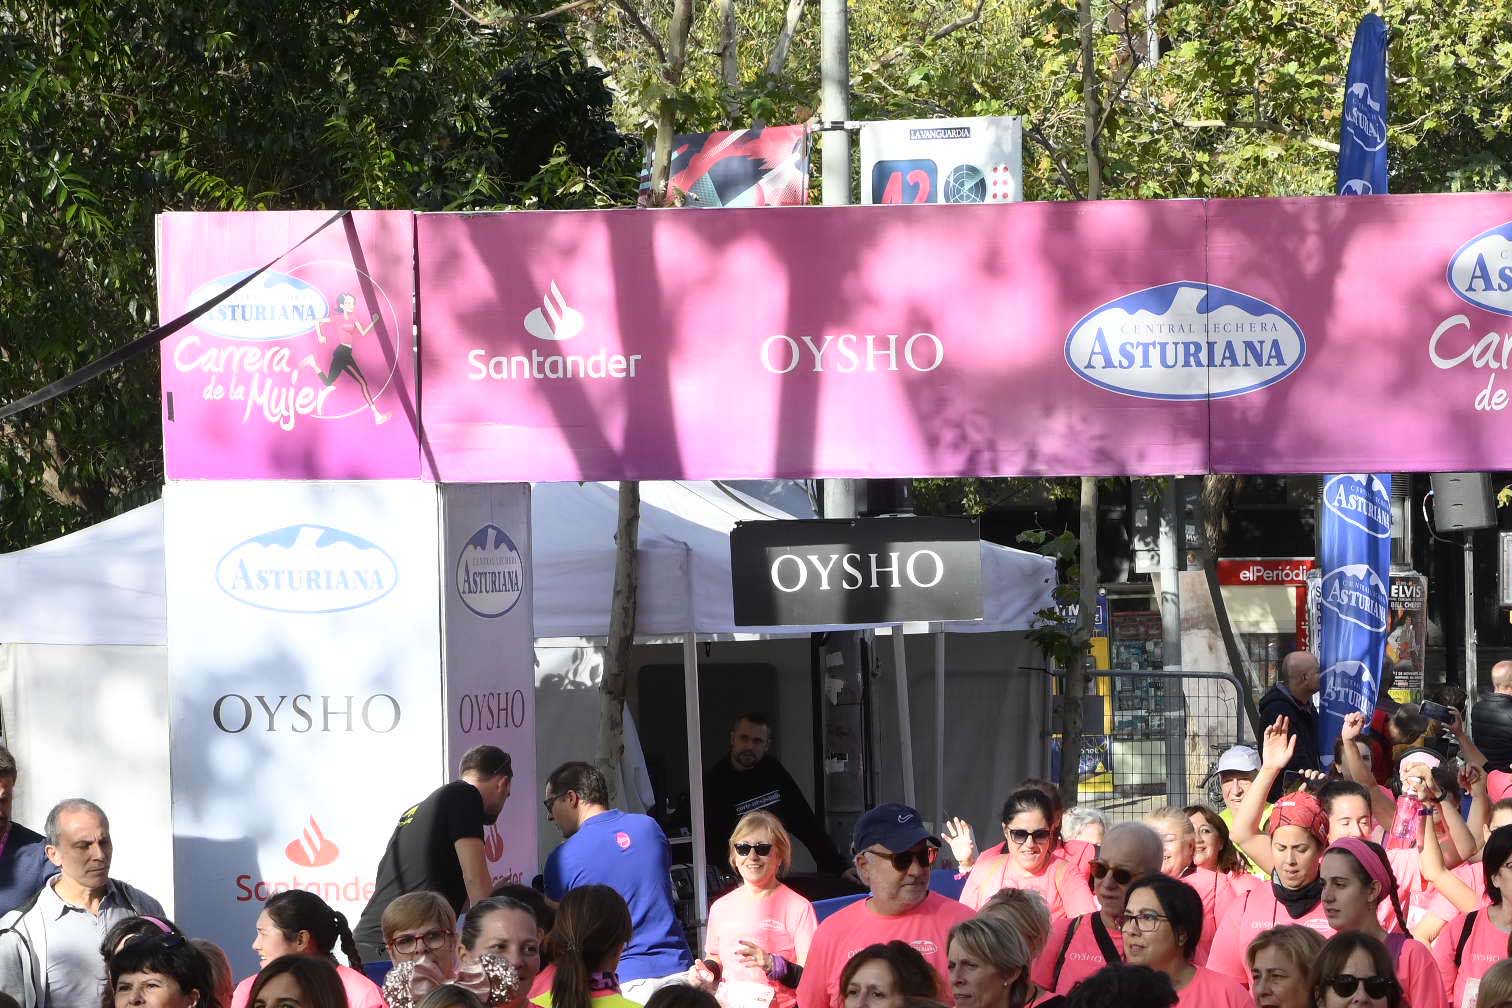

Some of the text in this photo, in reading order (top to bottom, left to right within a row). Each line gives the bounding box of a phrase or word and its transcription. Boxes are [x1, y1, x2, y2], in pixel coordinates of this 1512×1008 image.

[1121, 321, 1279, 334] CENTRAL LECHERA
[174, 336, 293, 373] Carrera
[468, 347, 641, 381] Santander
[761, 332, 944, 373] OYSHO
[1084, 327, 1287, 370] ASTURIANA
[203, 375, 245, 401] de la
[242, 368, 337, 431] Mujer
[1474, 371, 1509, 411] de
[231, 557, 385, 592] ASTURIANA
[462, 559, 520, 594] ASTURIANA
[770, 549, 945, 593] OYSHO
[1240, 565, 1307, 581] elPeriódi
[212, 693, 402, 734] OYSHO
[459, 688, 526, 734] OYSHO
